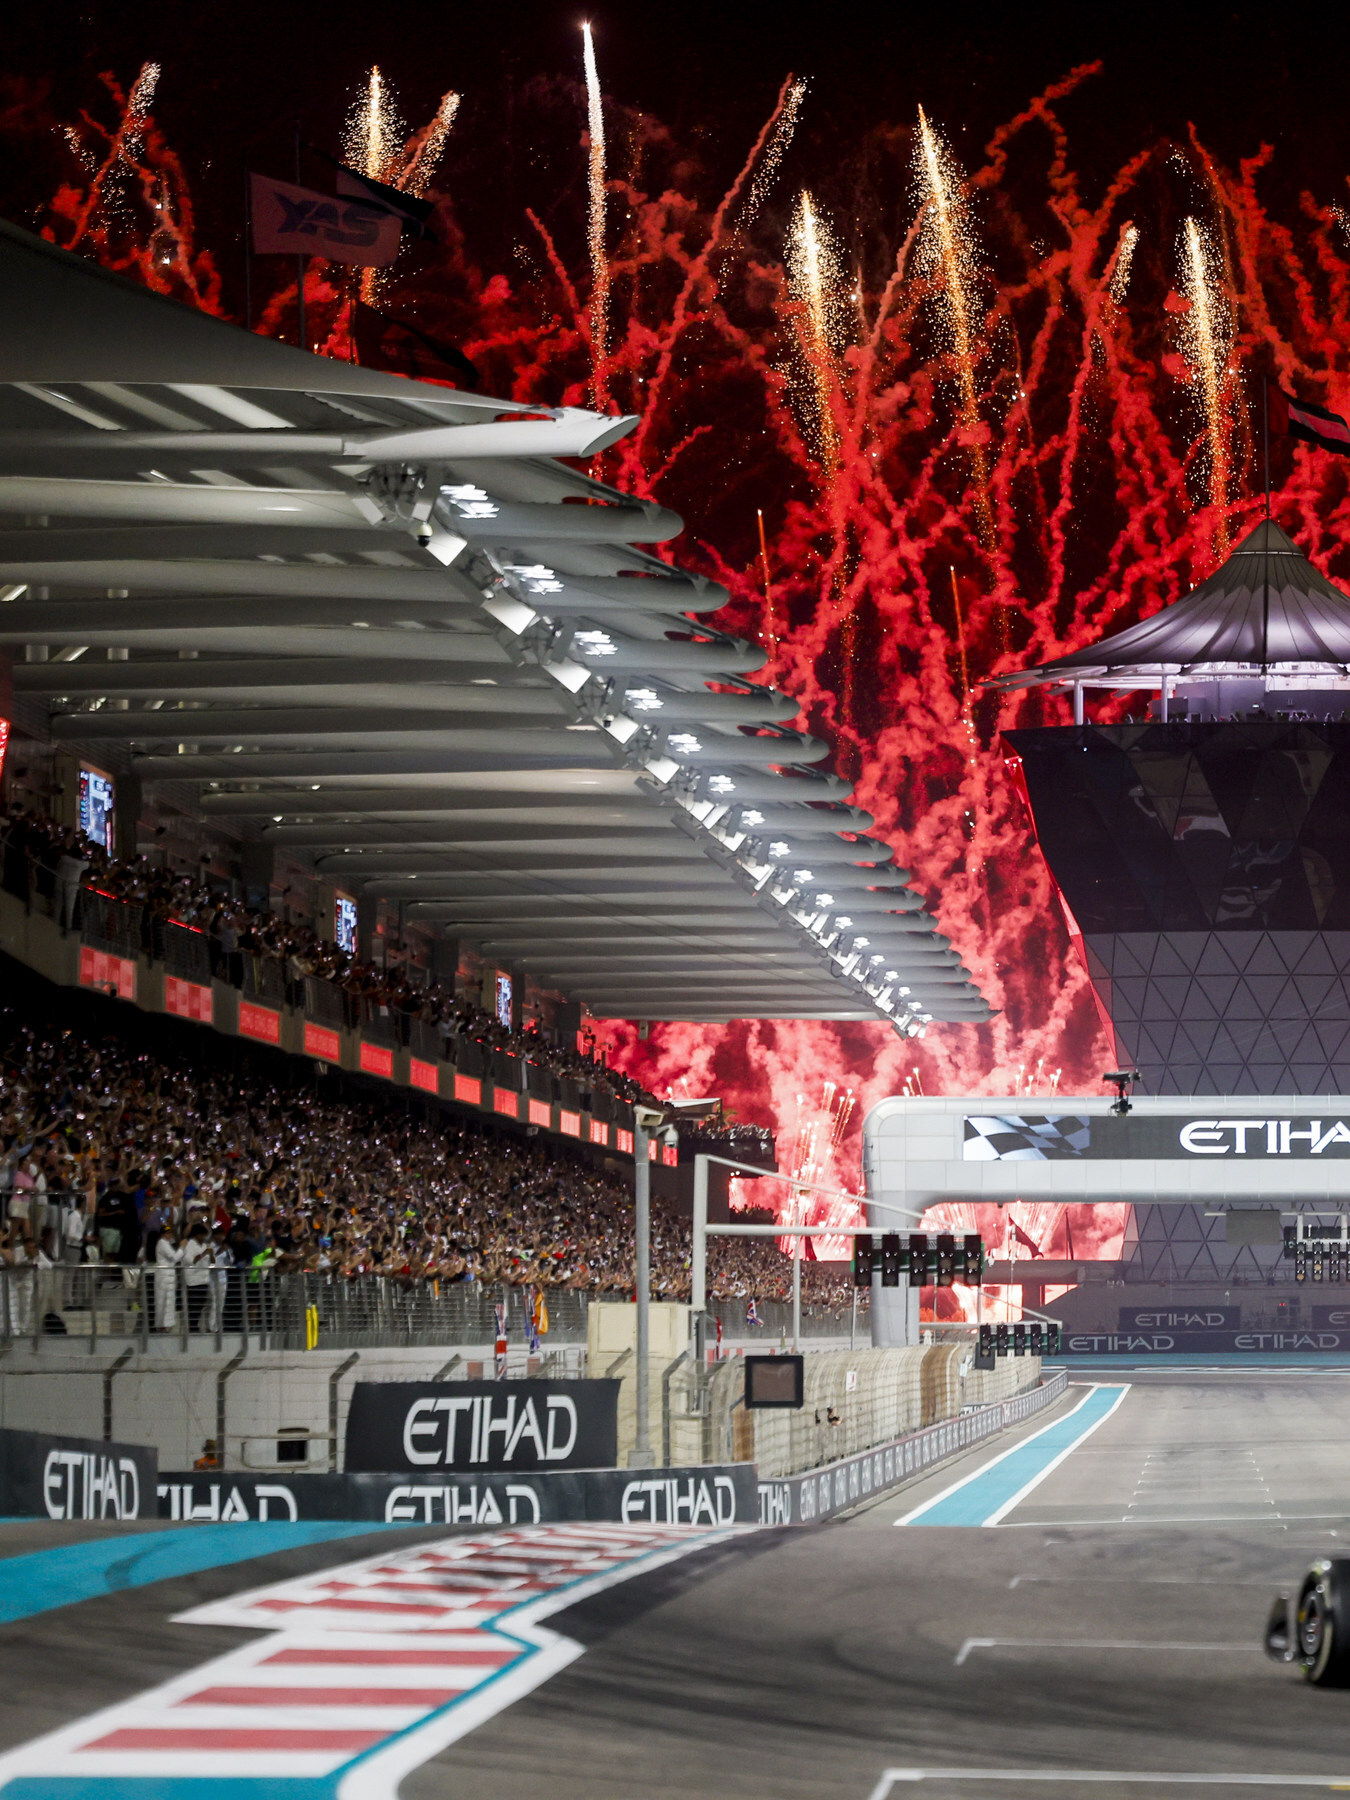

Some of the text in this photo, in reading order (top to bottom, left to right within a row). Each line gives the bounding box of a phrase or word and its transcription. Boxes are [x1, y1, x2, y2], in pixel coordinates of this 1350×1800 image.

[274, 192, 388, 247] YAS
[1069, 1334, 1340, 1351] ETIHAD ETIHAD
[1135, 1313, 1224, 1326] ETIHAD
[404, 1395, 577, 1464] ETIHAD
[44, 1450, 139, 1520] ETIHAD
[621, 1475, 736, 1526] ETIHAD
